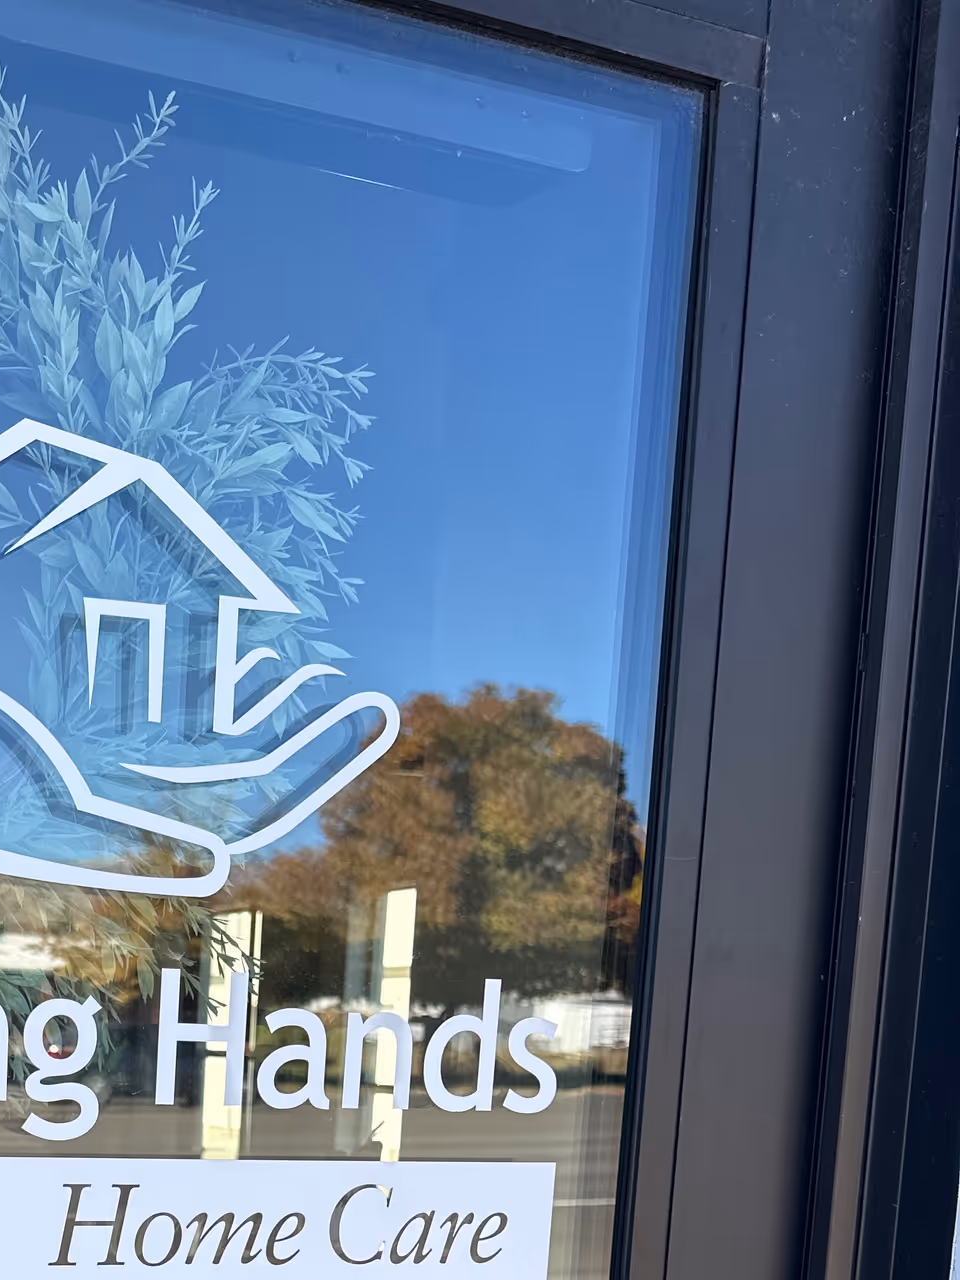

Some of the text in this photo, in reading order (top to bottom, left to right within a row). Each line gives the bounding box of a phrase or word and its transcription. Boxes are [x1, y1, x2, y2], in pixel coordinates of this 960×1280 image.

[155, 968, 559, 1114] Hands
[48, 1183, 509, 1267] Home Care
